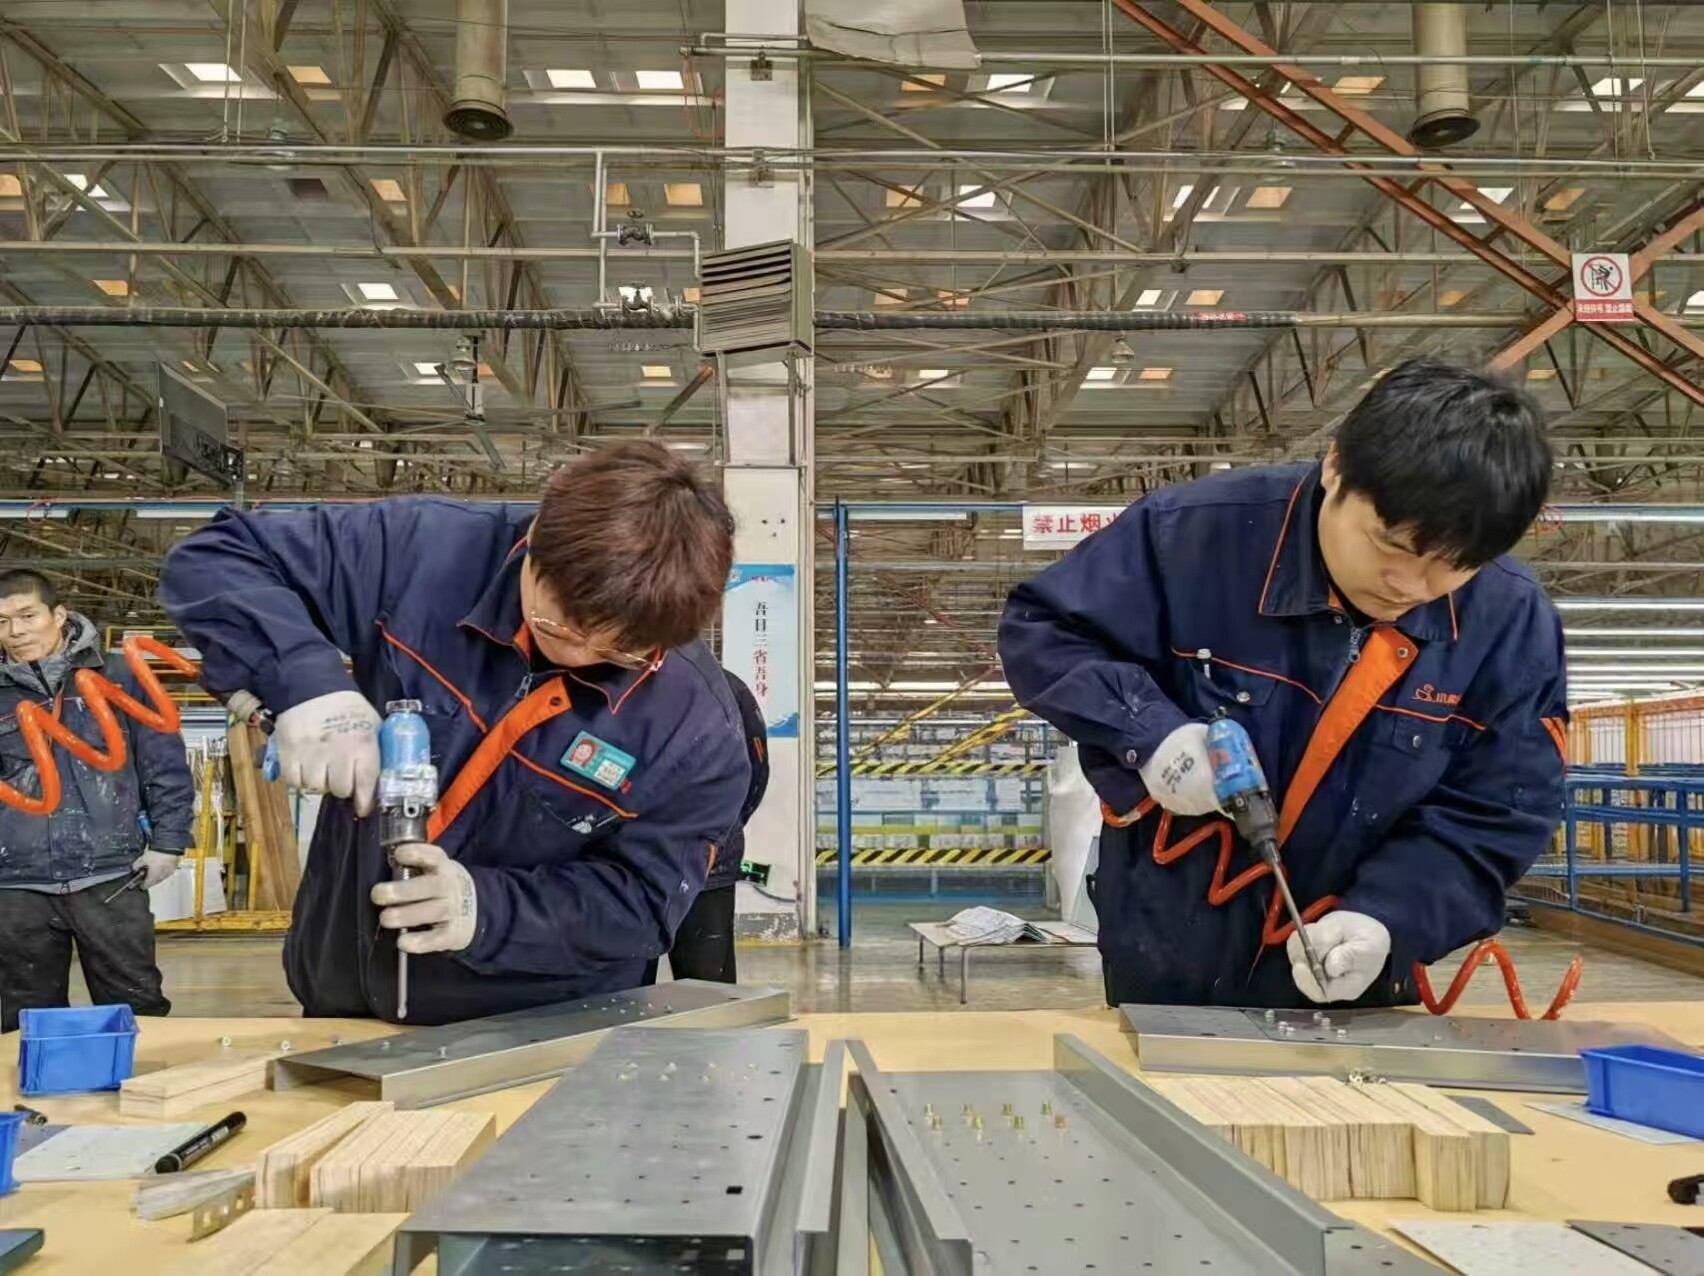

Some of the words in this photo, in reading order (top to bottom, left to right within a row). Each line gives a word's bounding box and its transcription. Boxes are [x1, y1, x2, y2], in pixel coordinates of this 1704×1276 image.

[753, 601, 769, 697] 吾日三省吾身
